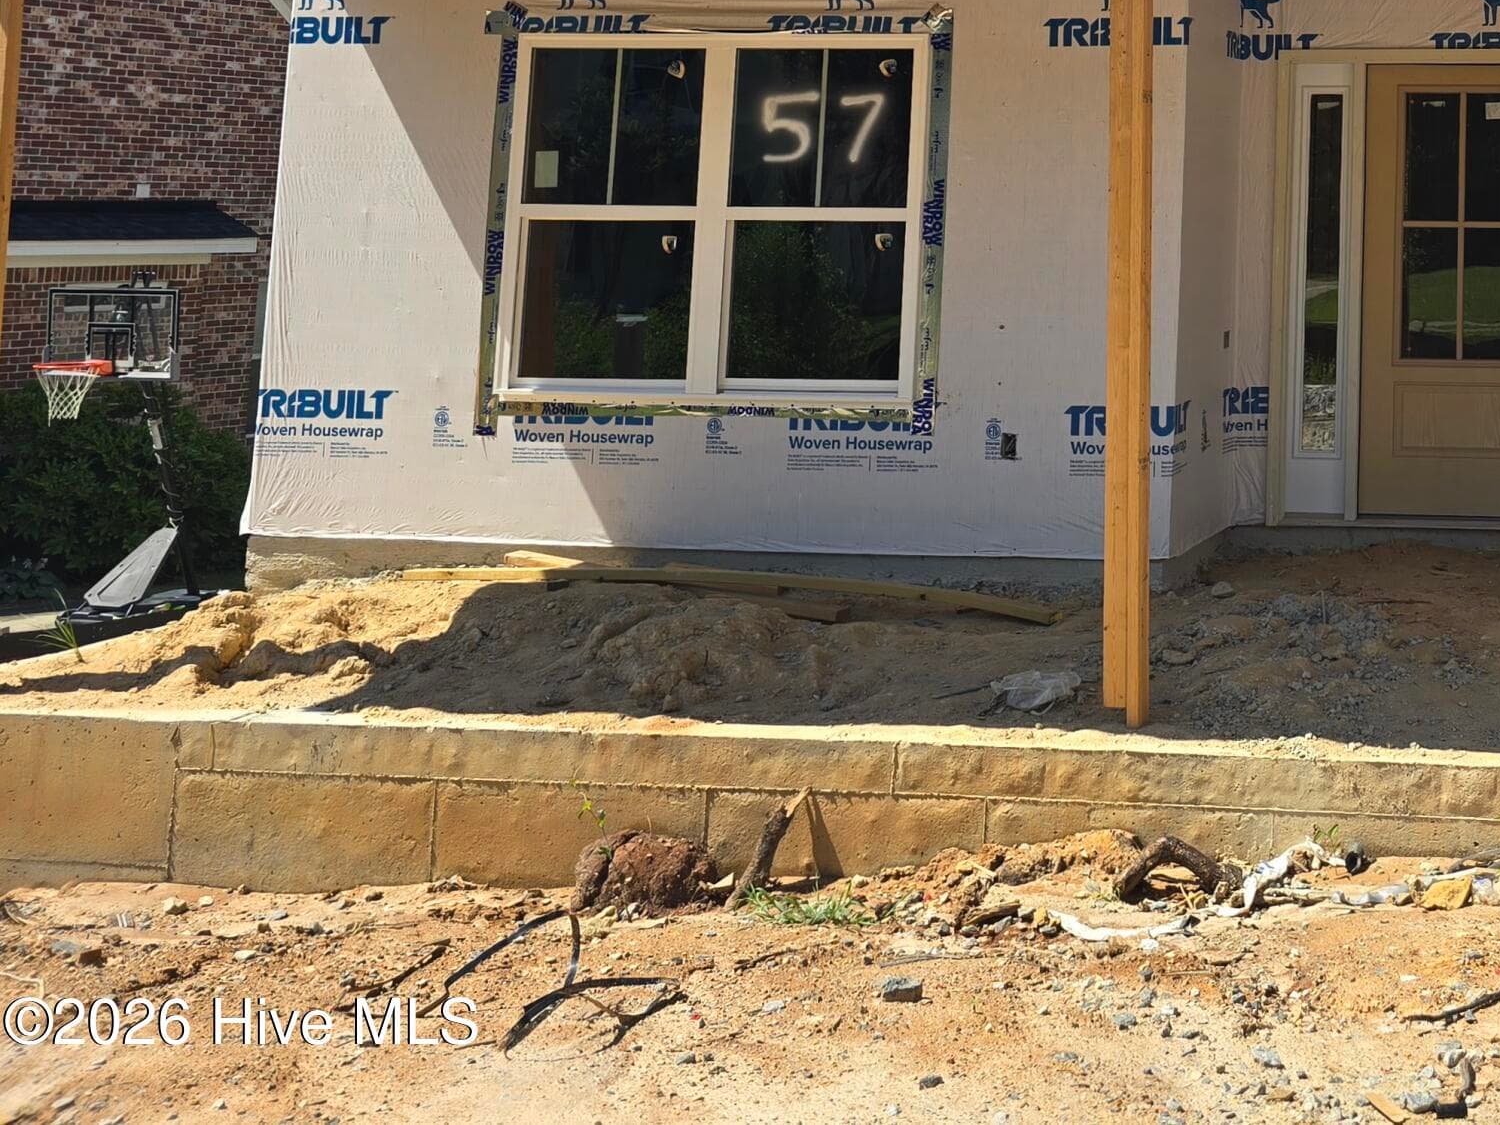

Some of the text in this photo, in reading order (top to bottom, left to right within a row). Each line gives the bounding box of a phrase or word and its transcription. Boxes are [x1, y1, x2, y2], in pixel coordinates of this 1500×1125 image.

[761, 90, 886, 164] 57
[301, 424, 384, 441] Housewrap
[514, 429, 655, 448] Woven Housewrap
[789, 436, 933, 454] Woven Housewrap
